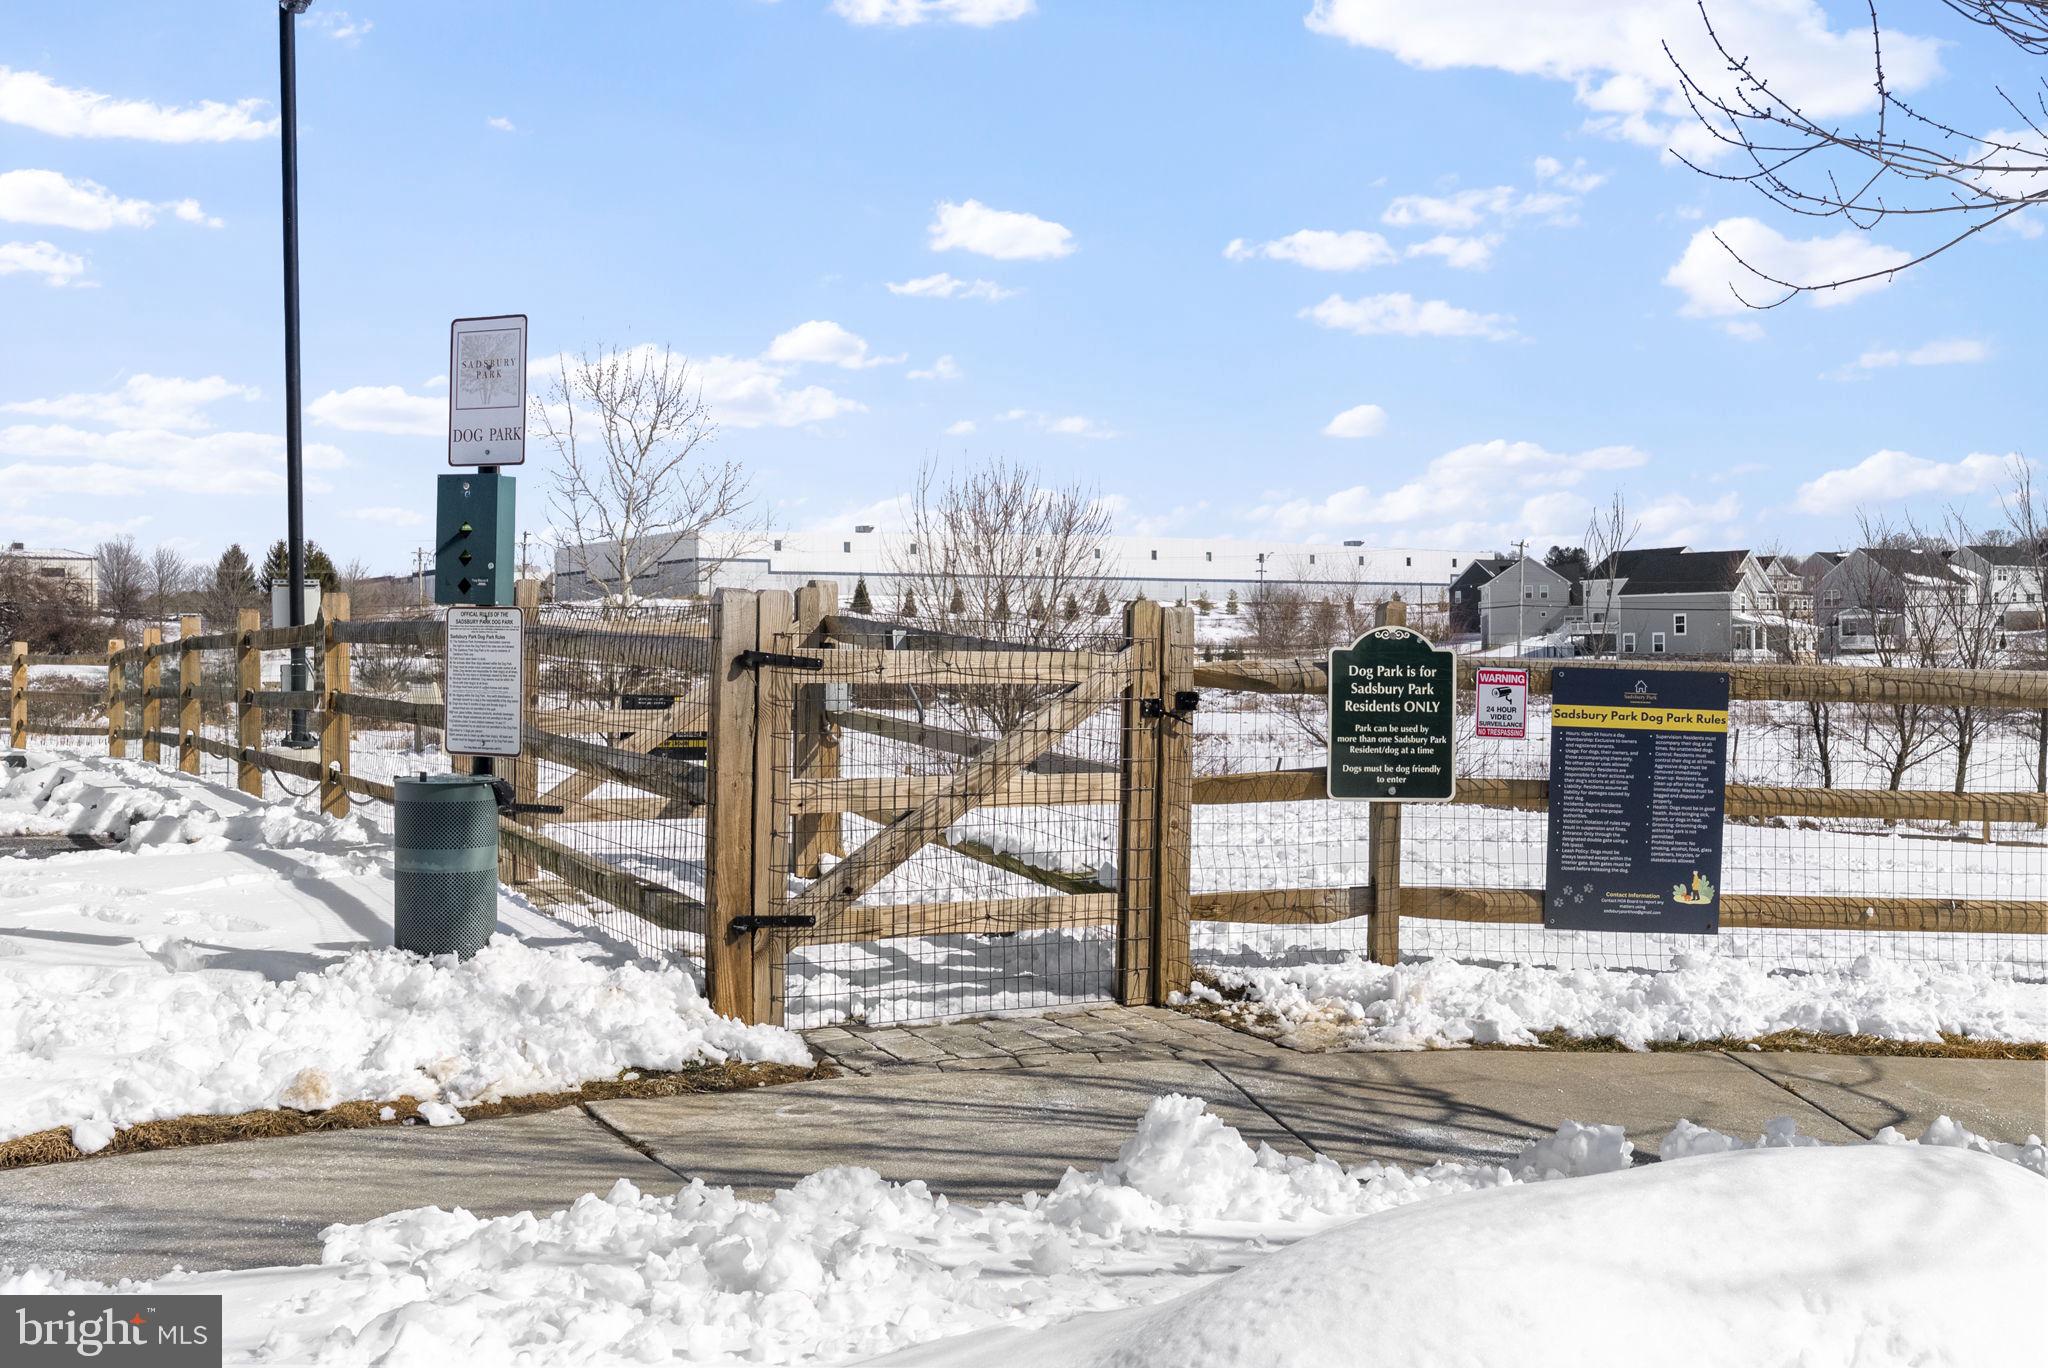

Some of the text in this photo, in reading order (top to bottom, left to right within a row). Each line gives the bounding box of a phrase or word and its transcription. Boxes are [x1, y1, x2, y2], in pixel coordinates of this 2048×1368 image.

[462, 358, 516, 369] SADSBURY
[476, 370, 502, 379] PARK
[454, 427, 522, 442] DOG PARK
[1349, 665, 1437, 679] Dog Park is for
[1480, 673, 1525, 683] WARNING
[1351, 682, 1434, 697] Sadsbury Park
[1345, 700, 1440, 712] Residents ONLY
[1554, 709, 1726, 724] Sadsbury Park Dog Park Rules
[1420, 725, 1429, 734] by
[1394, 736, 1428, 745] Sadsbury
[1350, 746, 1399, 755] Resident/dog
[1343, 765, 1362, 774] Dogs
[1396, 765, 1410, 774] dog
[1412, 765, 1441, 775] friendly
